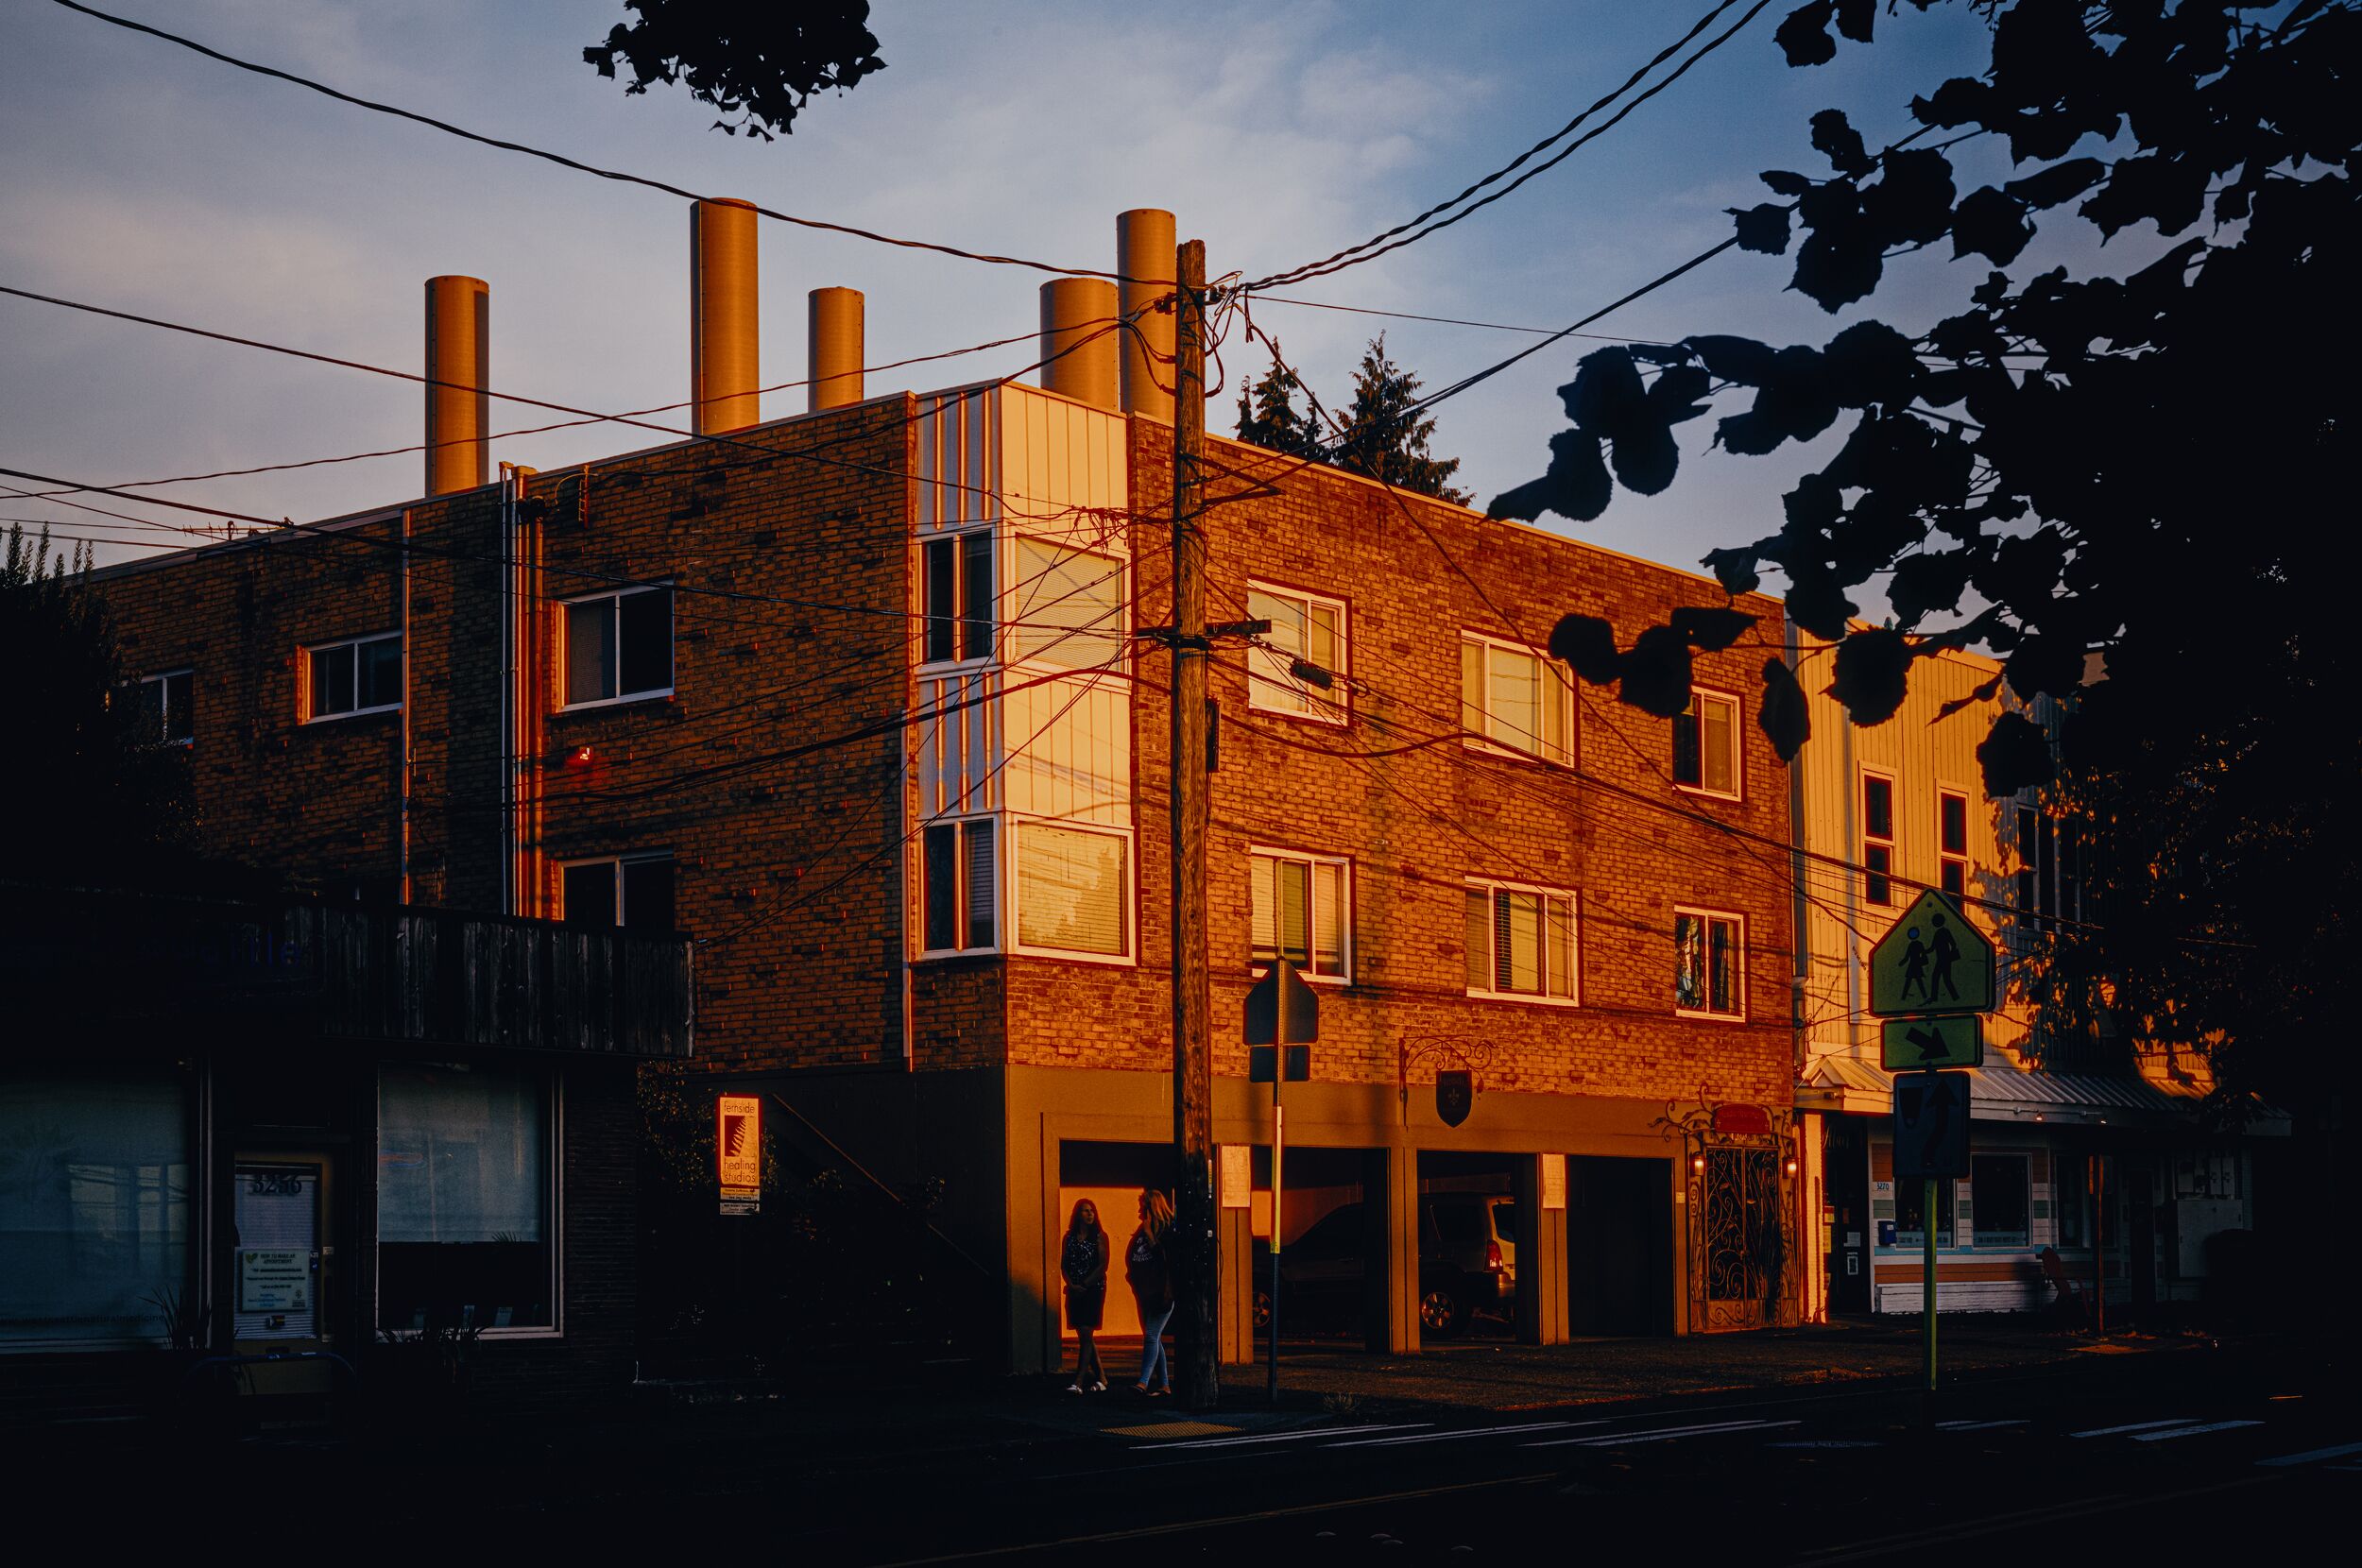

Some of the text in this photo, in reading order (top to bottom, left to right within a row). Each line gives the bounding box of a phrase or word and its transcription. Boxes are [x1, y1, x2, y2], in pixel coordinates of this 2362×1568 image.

[724, 1100, 755, 1115] fernside
[724, 1157, 756, 1174] healing
[724, 1171, 756, 1183] studios
